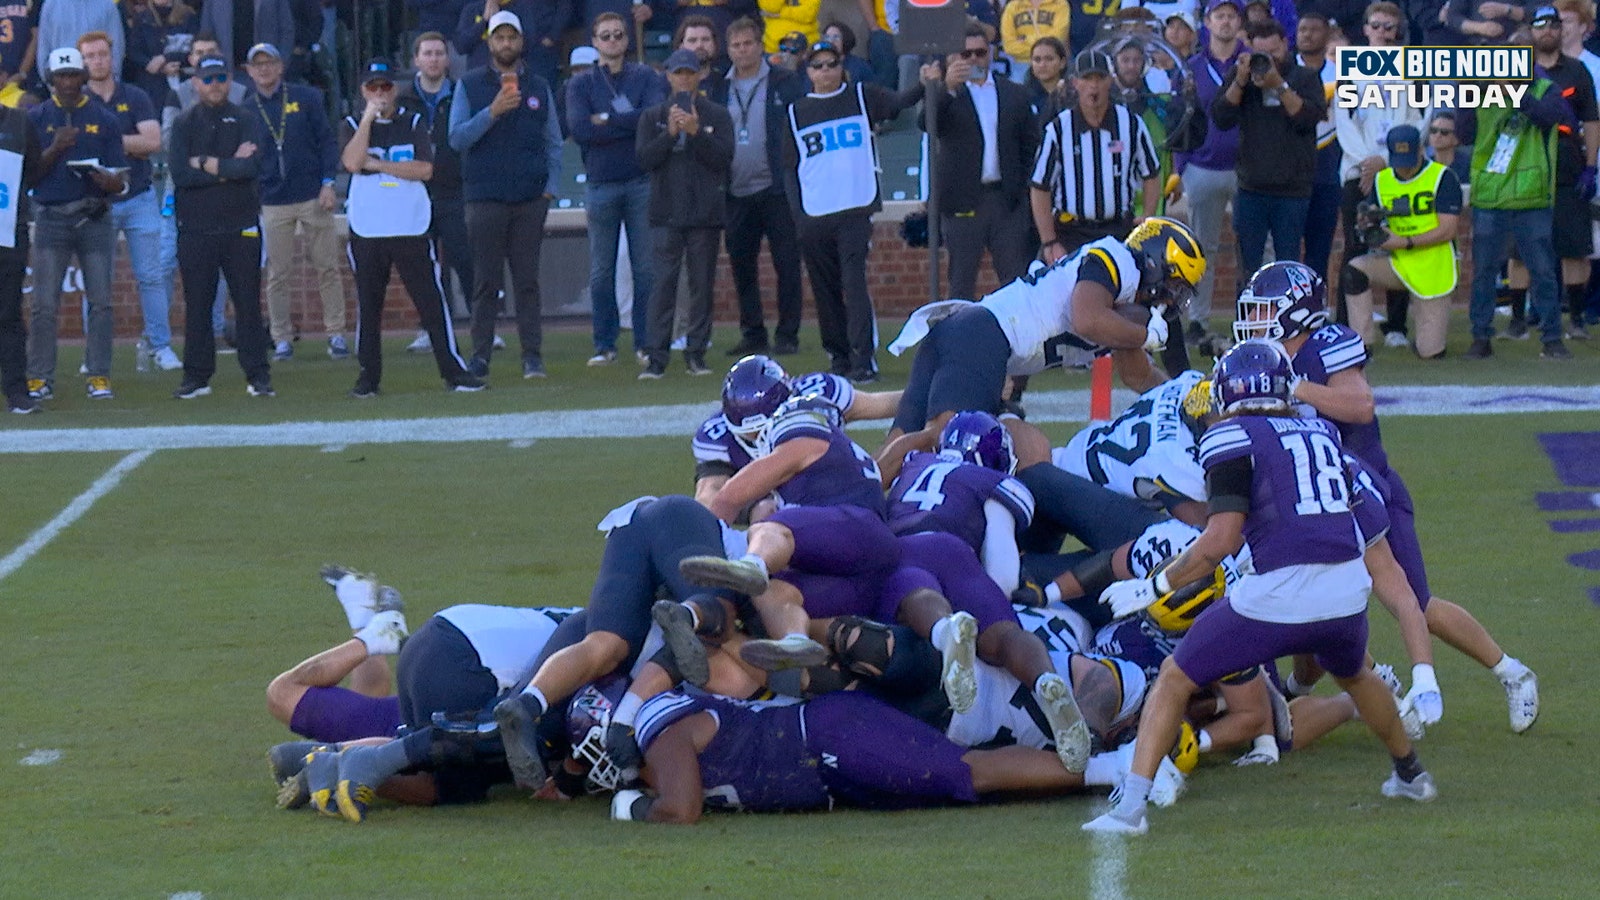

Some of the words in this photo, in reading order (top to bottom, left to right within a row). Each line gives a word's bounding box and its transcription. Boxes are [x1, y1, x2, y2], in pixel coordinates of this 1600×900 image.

[1249, 374, 1271, 394] 18
[949, 429, 959, 446] 4
[901, 462, 961, 512] 4
[1279, 432, 1350, 516] 18
